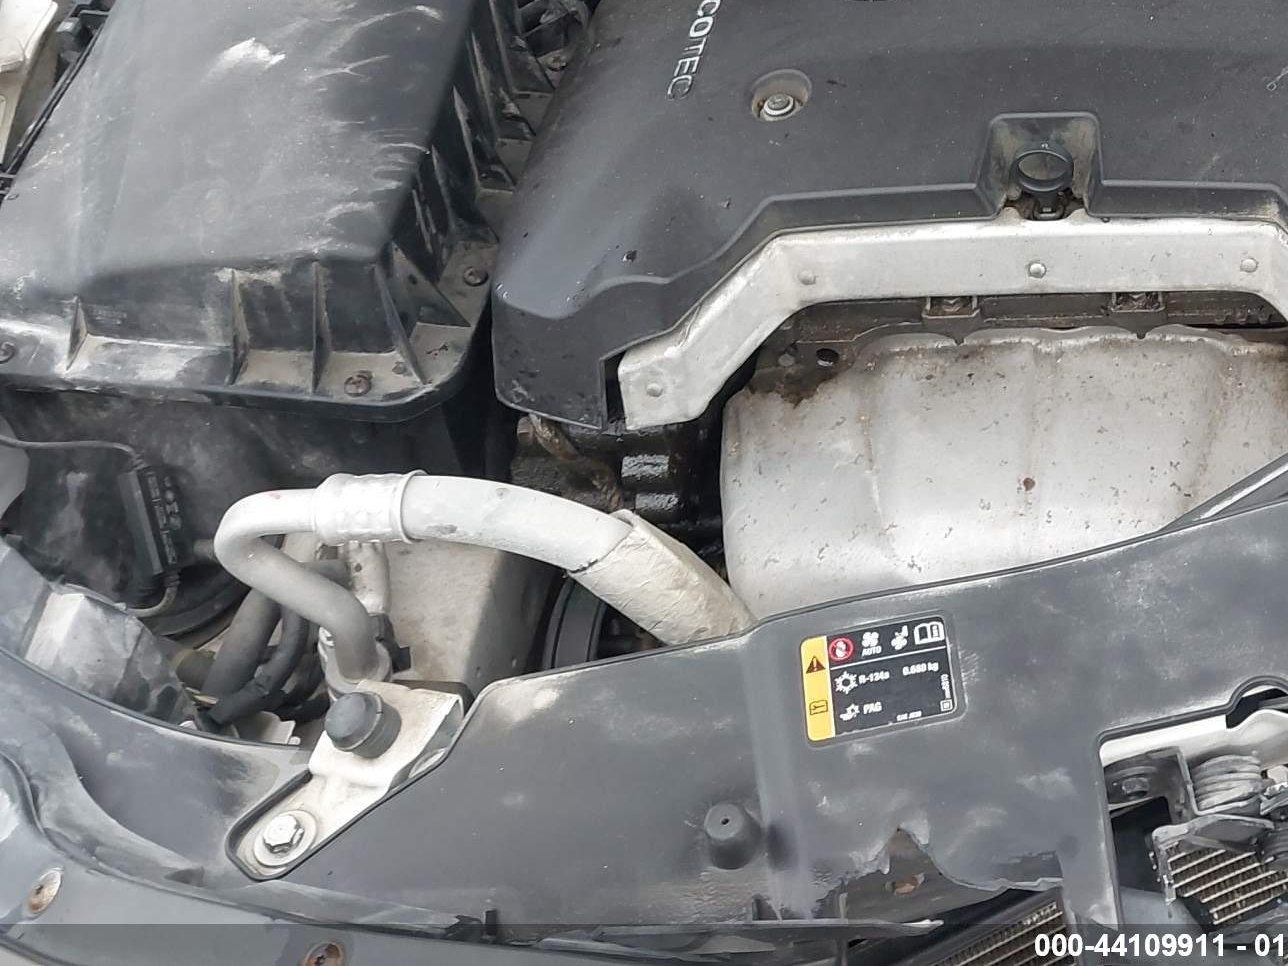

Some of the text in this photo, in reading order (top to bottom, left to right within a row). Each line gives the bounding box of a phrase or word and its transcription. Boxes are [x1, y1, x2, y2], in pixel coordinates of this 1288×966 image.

[861, 645, 882, 657] AUTO
[858, 670, 890, 685] R-134a
[927, 662, 939, 672] kg
[863, 701, 883, 715] PAG
